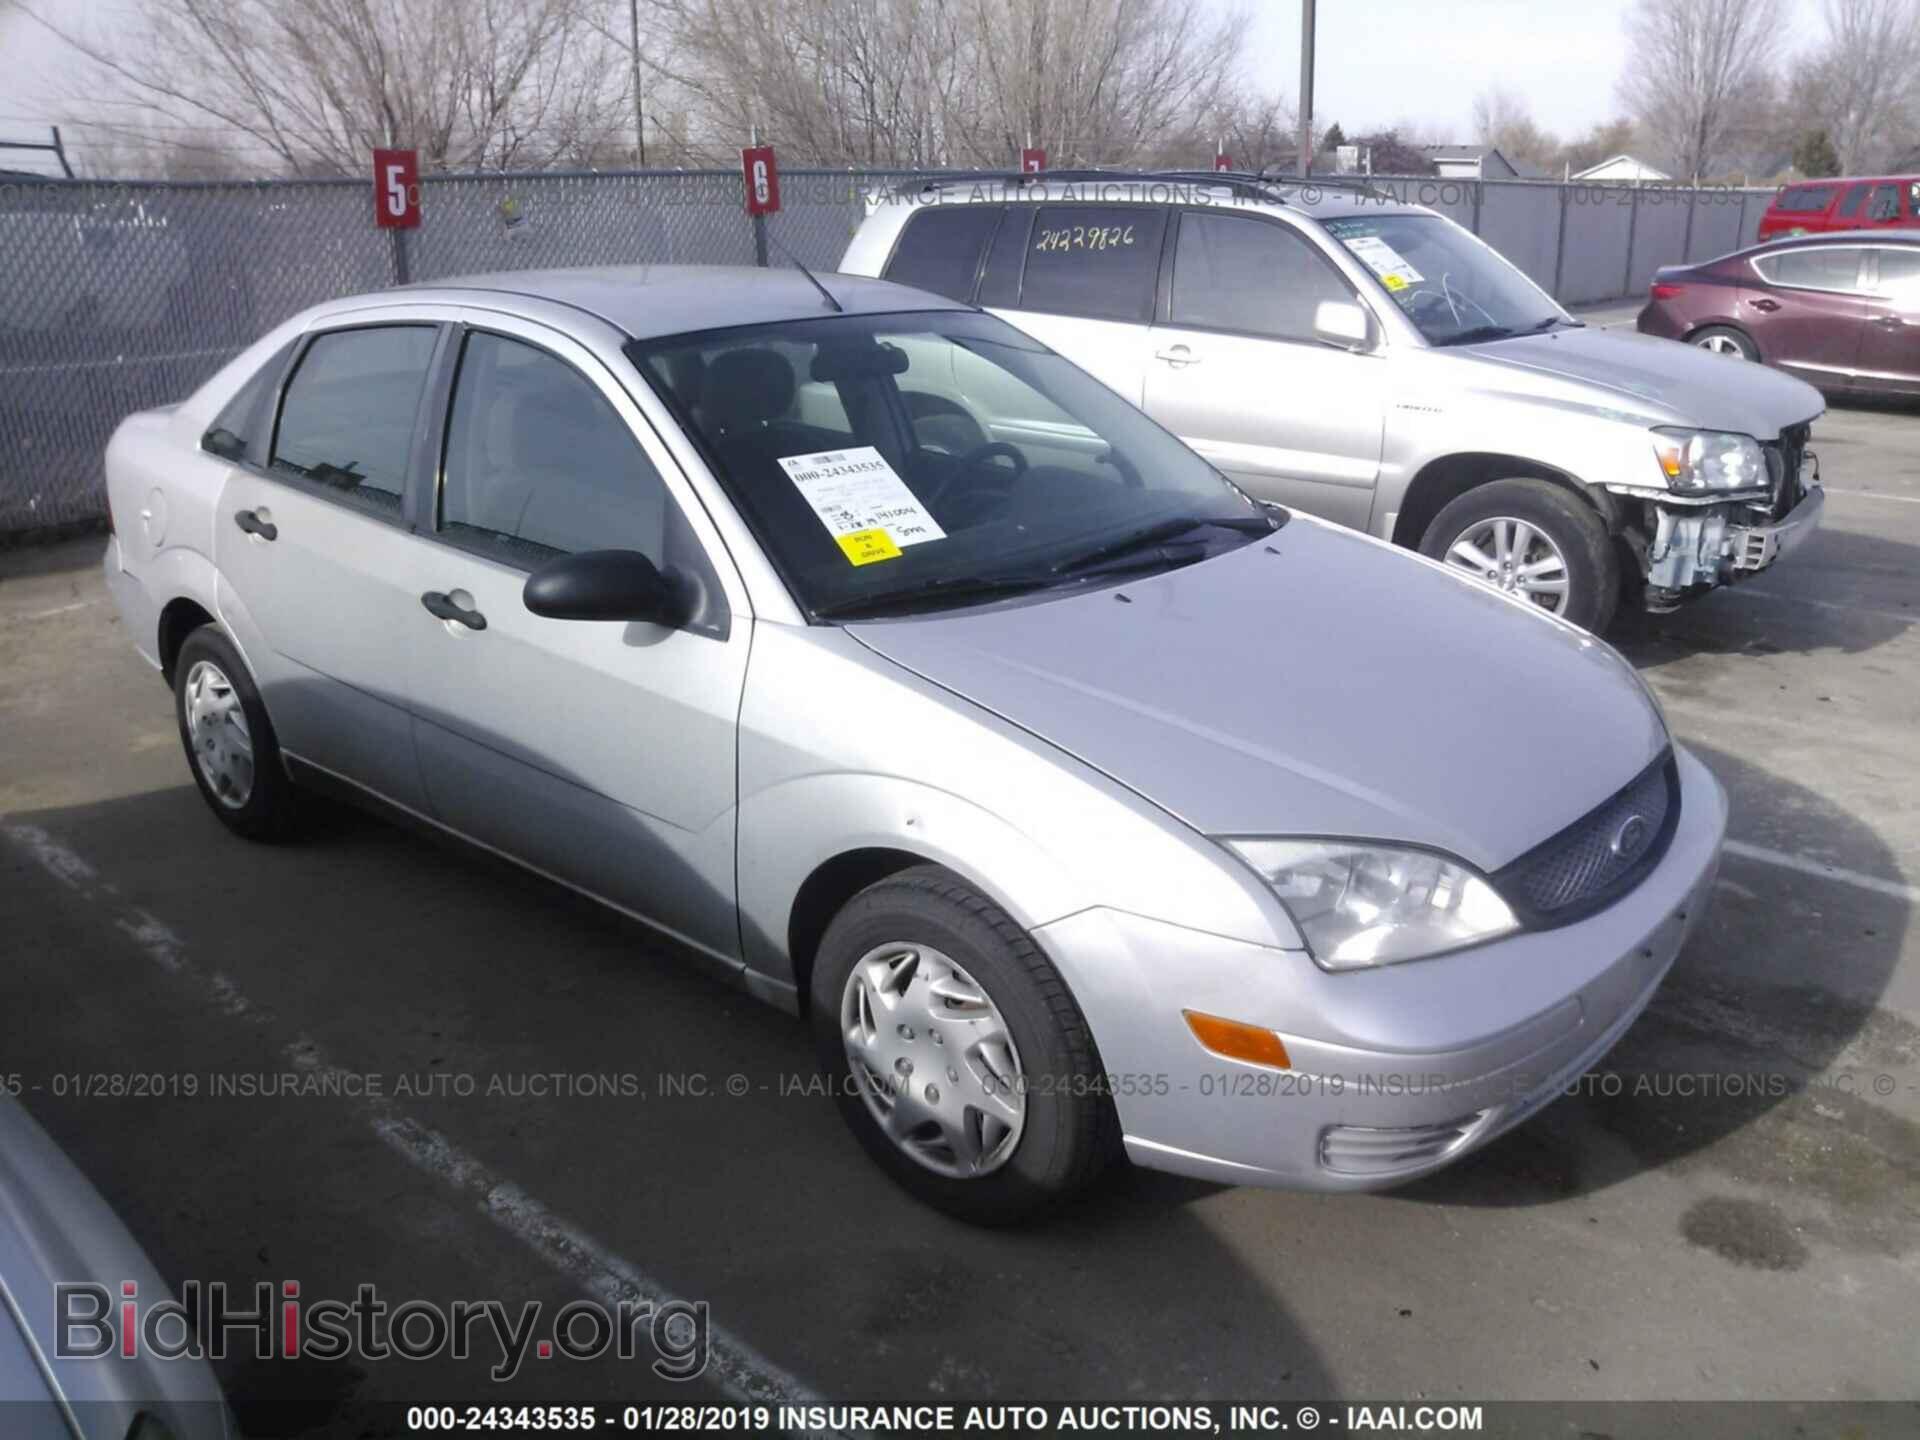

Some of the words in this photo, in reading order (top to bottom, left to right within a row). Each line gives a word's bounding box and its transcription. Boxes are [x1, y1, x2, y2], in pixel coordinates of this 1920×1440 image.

[385, 165, 406, 216] 5
[752, 160, 769, 204] 6
[1036, 226, 1135, 251] 24229826
[793, 460, 886, 483] 000-24343535
